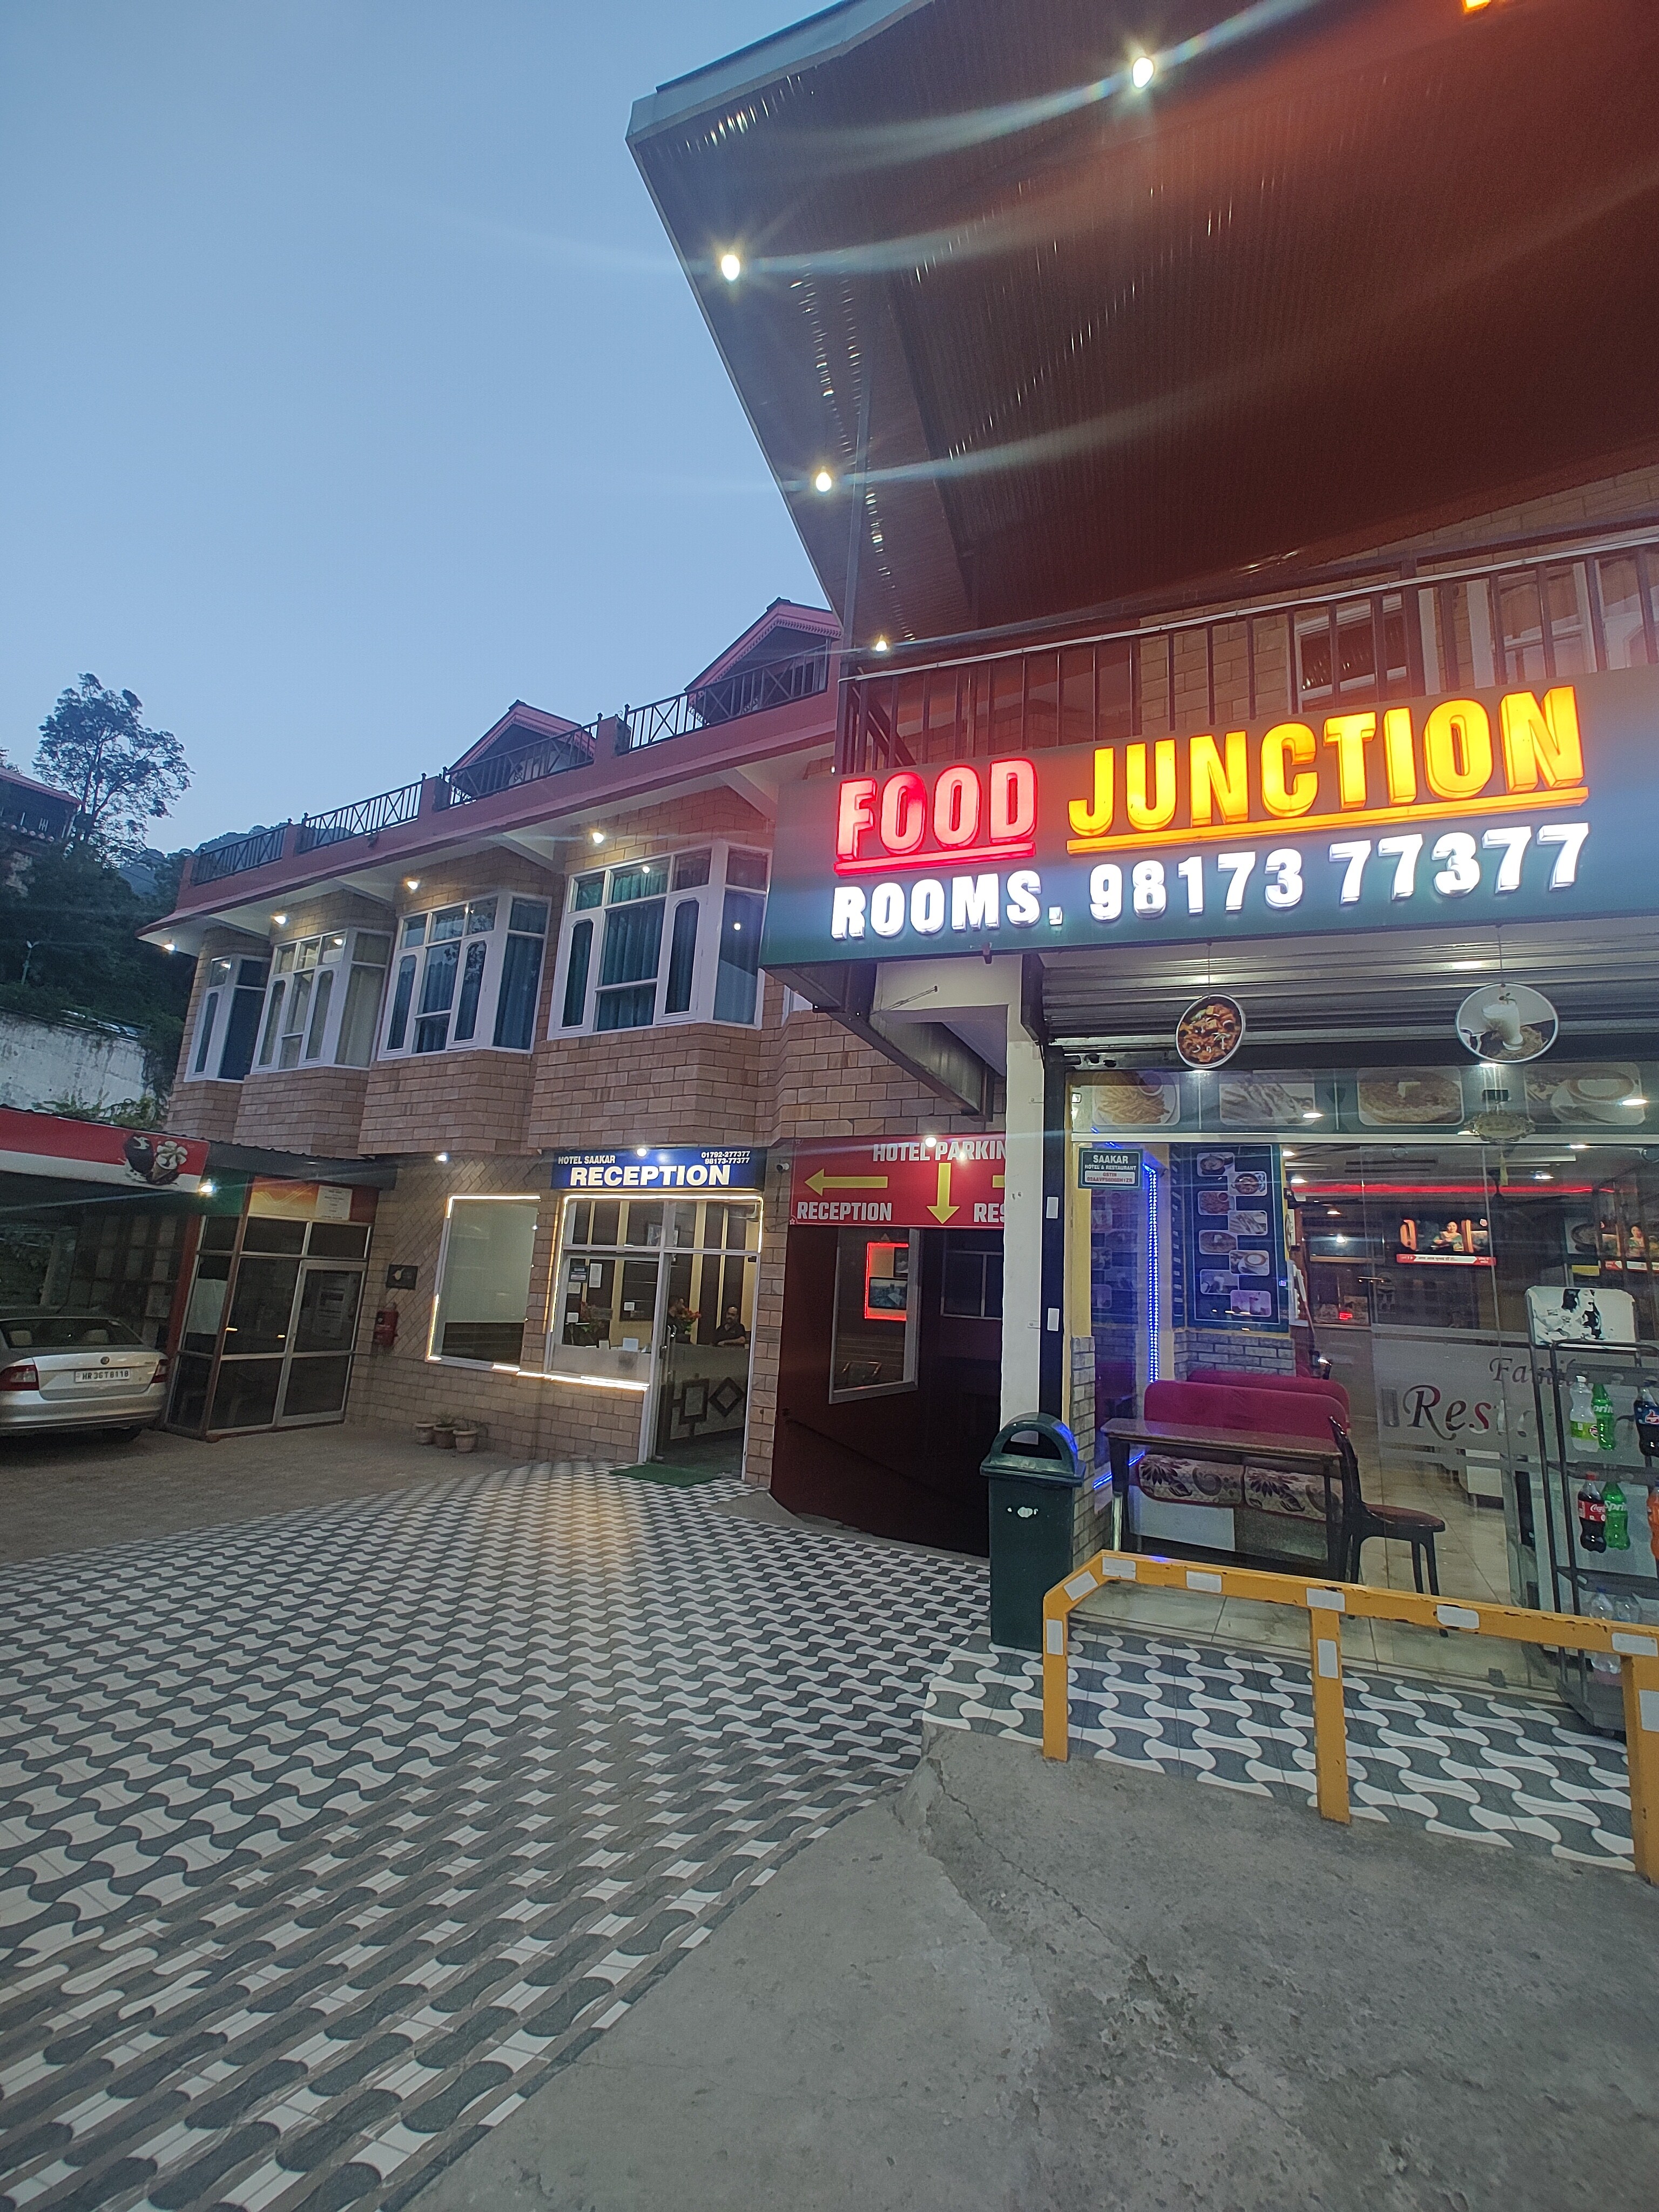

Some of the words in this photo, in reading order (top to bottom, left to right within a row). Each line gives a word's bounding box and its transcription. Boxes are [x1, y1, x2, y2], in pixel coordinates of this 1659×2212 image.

[836, 758, 1037, 860] FOOD
[1068, 686, 1584, 837] JUNCTION
[1089, 848, 1304, 921] 98173
[1329, 822, 1589, 905] 77377
[558, 1156, 582, 1164] HOTEL
[584, 1155, 616, 1164] SAAKAR
[872, 1142, 930, 1162] HOTEL
[935, 1140, 1006, 1161] PARKIN
[1092, 1155, 1129, 1164] SAAKAR
[570, 1165, 730, 1186] RECEPTION
[797, 1202, 892, 1222] RECEPTION
